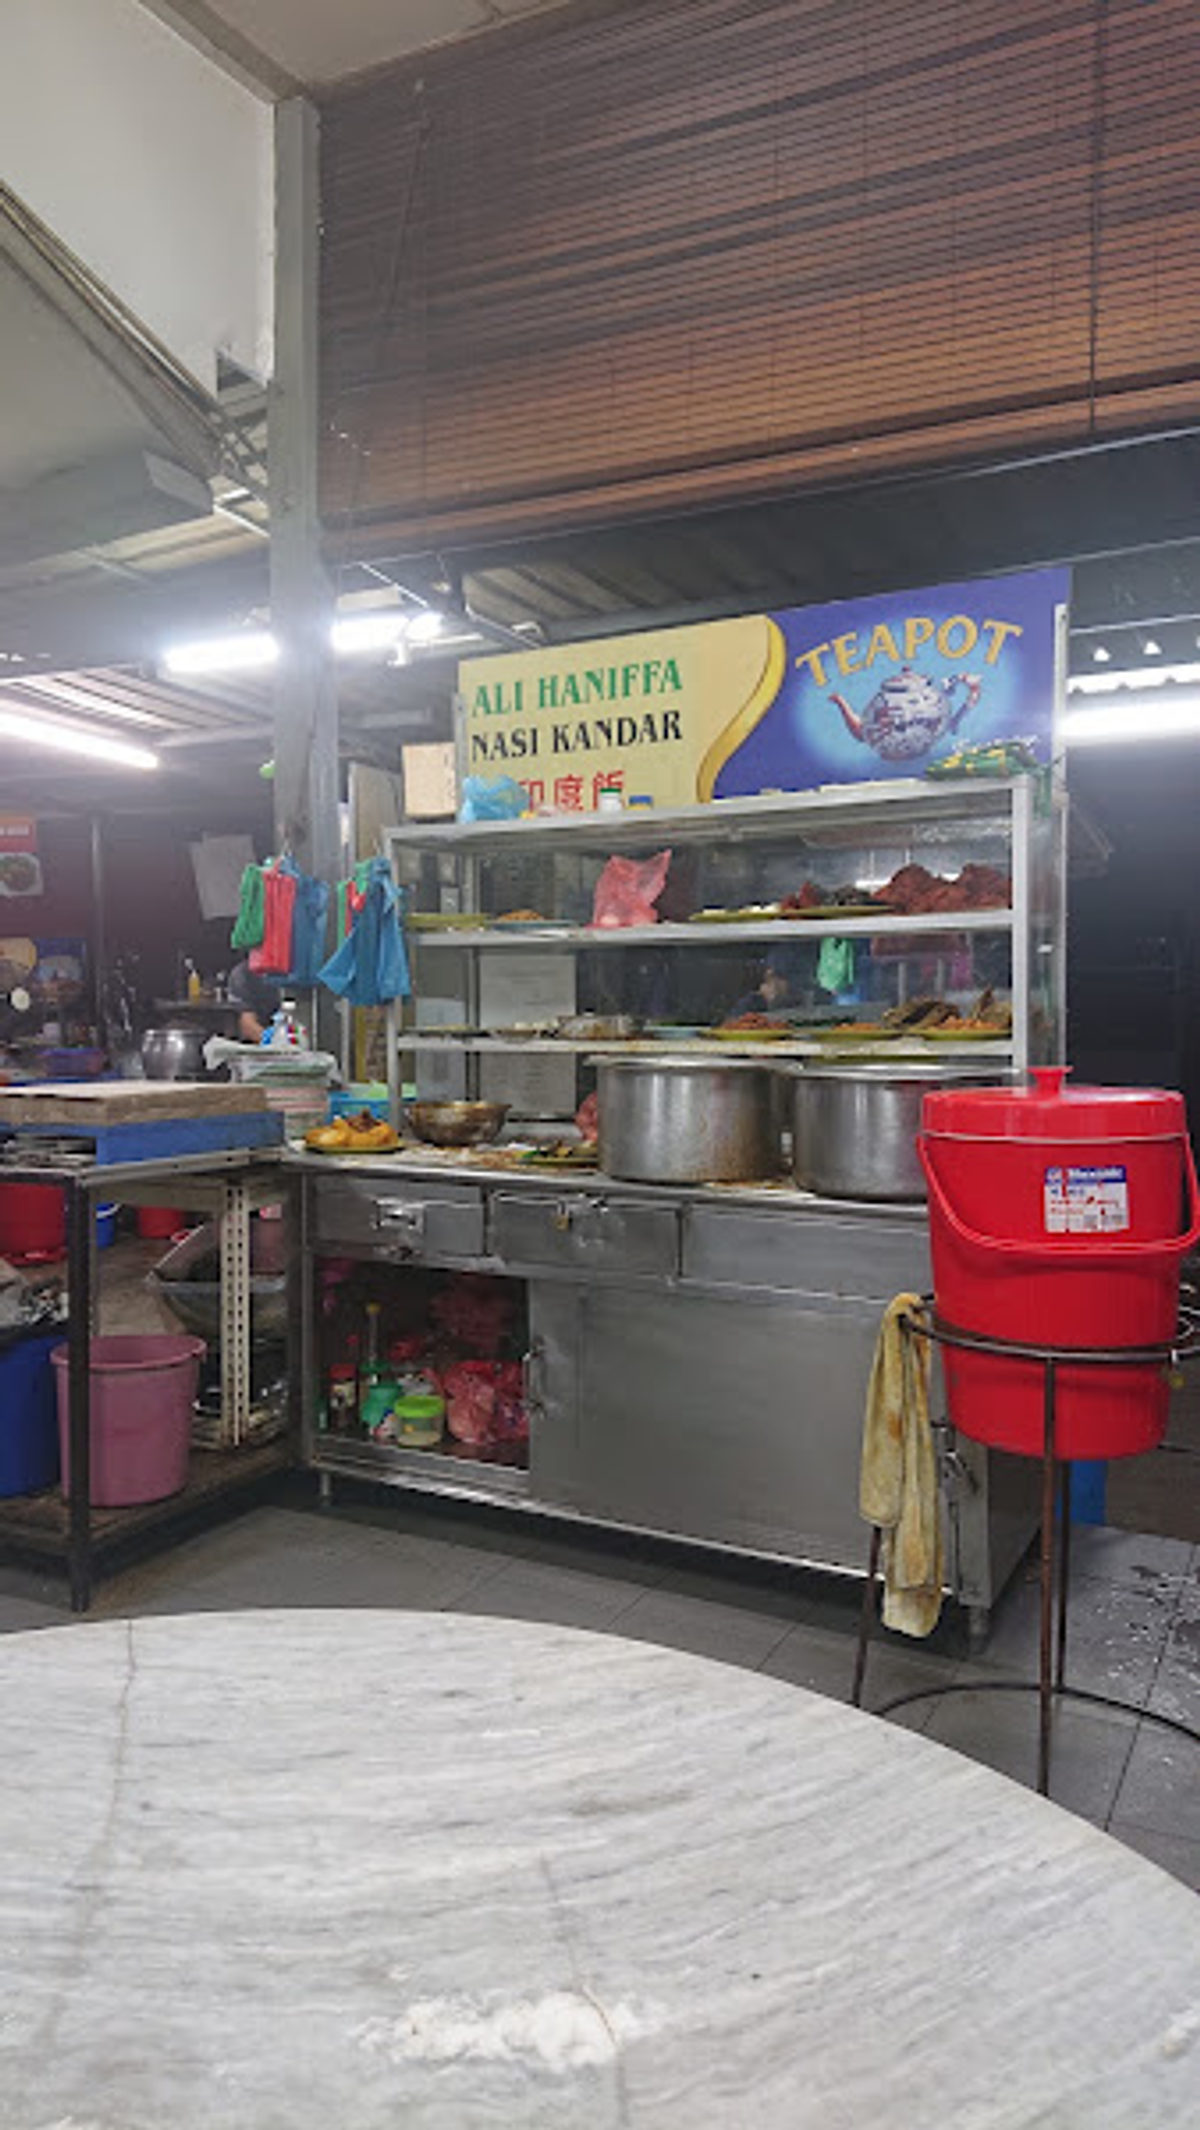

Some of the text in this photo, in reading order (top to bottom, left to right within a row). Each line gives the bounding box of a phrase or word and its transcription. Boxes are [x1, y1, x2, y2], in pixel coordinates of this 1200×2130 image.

[795, 614, 1023, 686] TEAPOT
[472, 657, 684, 717] ALI HANIFFA
[471, 709, 684, 762] NASI KANDAR
